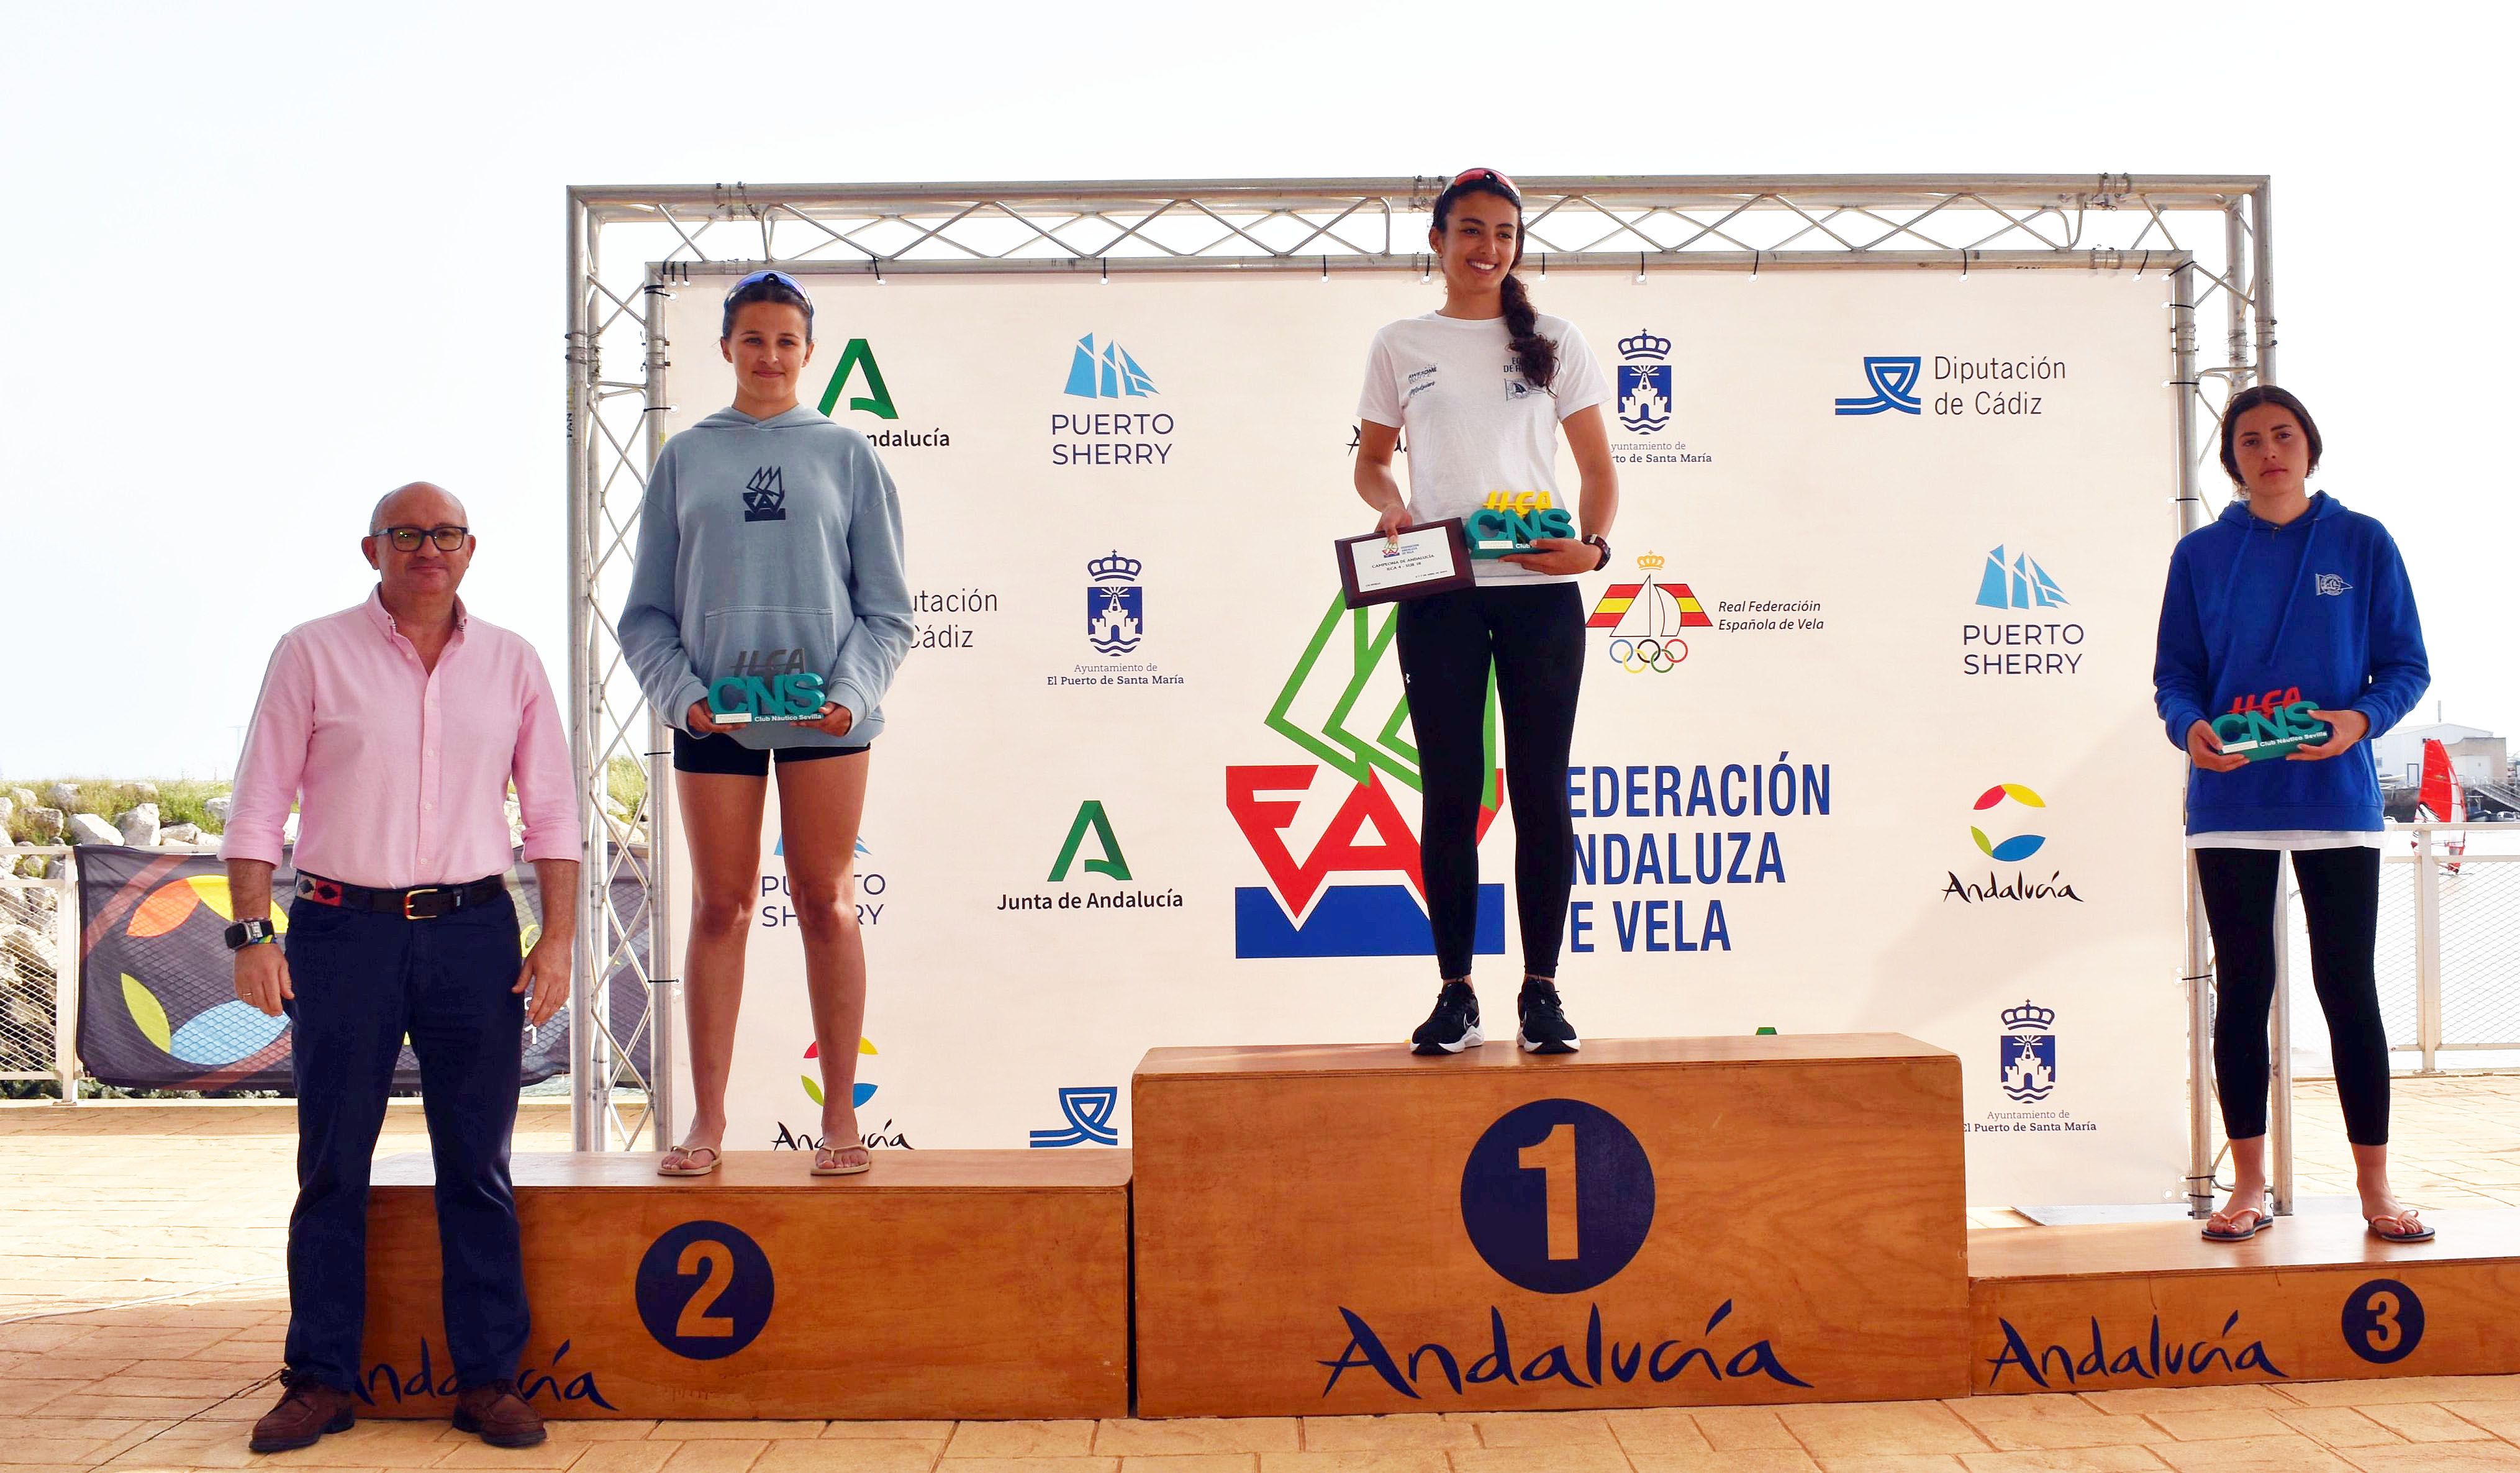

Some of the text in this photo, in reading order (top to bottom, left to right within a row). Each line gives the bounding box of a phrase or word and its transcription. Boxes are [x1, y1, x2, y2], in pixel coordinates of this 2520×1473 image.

[1935, 355, 2066, 384] Diputación
[1934, 391, 2042, 415] de Cádiz
[1052, 414, 1174, 435] PUERTO
[867, 427, 950, 447] ndalucía
[1610, 441, 1686, 453] yuntamiento de
[1053, 443, 1172, 465] SHERRY
[1629, 454, 1643, 463] de
[1646, 454, 1677, 463] Santa
[1680, 453, 1712, 463] María
[1466, 508, 1576, 542] CNS
[1371, 561, 1399, 569] CAMPEONA
[1407, 554, 1434, 563] ANDALUCÍA
[1718, 600, 1821, 612] Real Federacióin
[1718, 618, 1824, 633] Española de Vela
[1964, 623, 2084, 646] PUERTO
[1074, 663, 1158, 675] Ayuntamiento de
[1964, 653, 2083, 675] SHERRY
[1046, 674, 1184, 686] El Puerto de Santa María
[707, 673, 825, 716] CNS
[2211, 700, 2324, 743] CNS
[2277, 735, 2303, 745] Náutico
[2305, 731, 2327, 740] Sevilla
[1566, 751, 1830, 818] EDERACIÓN
[1570, 832, 1786, 886] NDALUZA
[997, 887, 1183, 910] Junta de Andalucía
[1941, 870, 2085, 904] Andalucía
[1570, 899, 1731, 953] E VELA
[1974, 1122, 2010, 1132] Puerto
[2013, 1122, 2027, 1131] de
[2029, 1122, 2061, 1131] Santa
[2064, 1121, 2097, 1131] María
[1987, 1109, 2070, 1122] Ayuntamiento de
[1518, 1124, 1579, 1261] 1
[676, 1239, 735, 1338] 2
[2365, 1290, 2403, 1352] 3
[1316, 1298, 1815, 1400] Andalucía
[1986, 1308, 2290, 1389] Andalucía
